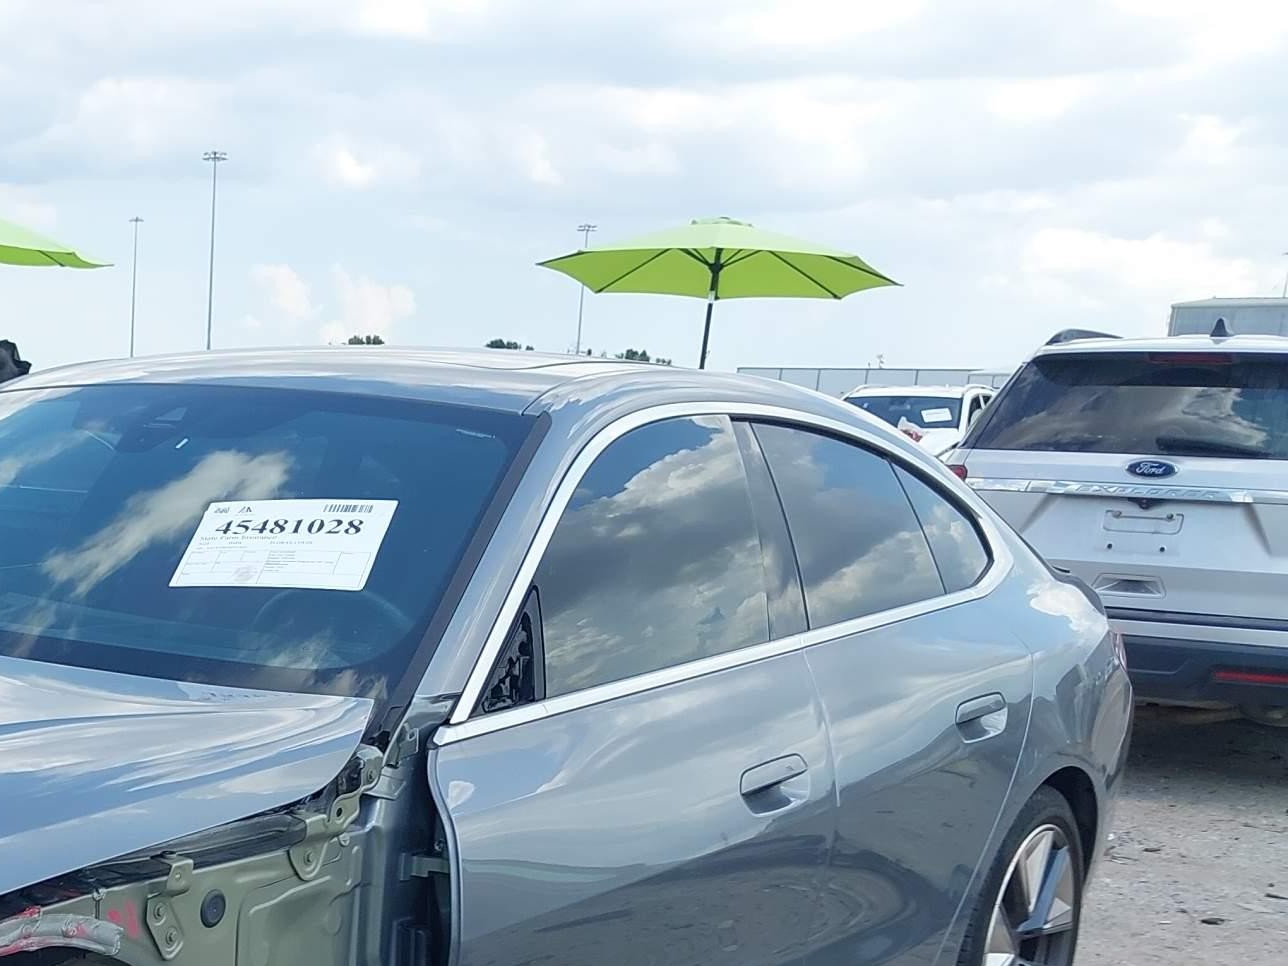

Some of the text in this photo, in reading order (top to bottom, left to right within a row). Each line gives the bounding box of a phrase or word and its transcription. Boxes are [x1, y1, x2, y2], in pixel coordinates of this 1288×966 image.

[1135, 460, 1165, 475] Ford
[1077, 484, 1221, 499] EXPLORER
[214, 518, 364, 535] 45481028
